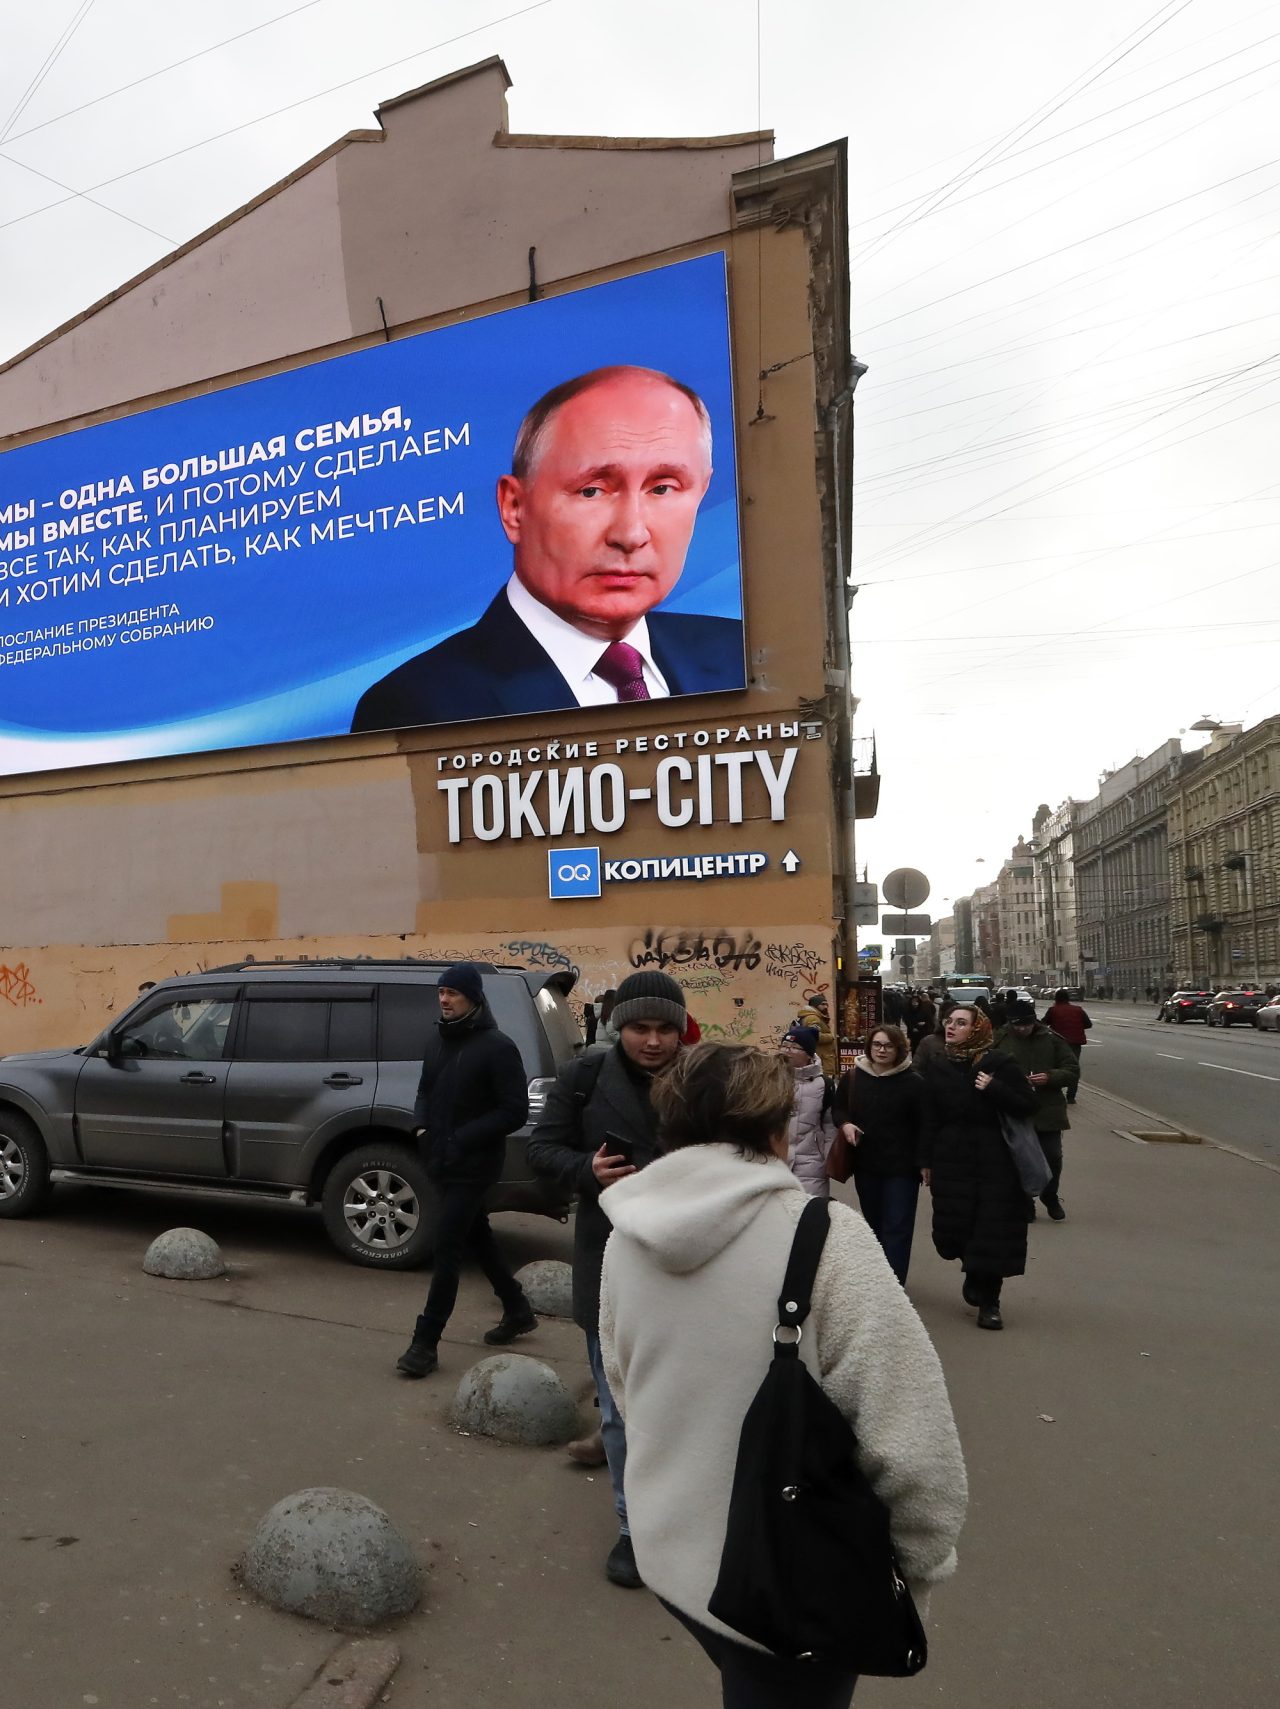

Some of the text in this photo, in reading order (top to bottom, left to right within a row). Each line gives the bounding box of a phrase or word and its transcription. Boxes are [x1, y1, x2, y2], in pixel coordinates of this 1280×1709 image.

[43, 501, 150, 542] ВМЕСТЕ,
[157, 493, 173, 516] И
[184, 462, 305, 509] ПОТОМУ
[315, 423, 469, 480] СДЕЛАЕМ
[60, 475, 135, 510] ОДНА
[143, 436, 285, 490] БОЛЬШАЯ
[295, 406, 411, 451] СЕМЬЯ,
[17, 569, 100, 604] ХОТИМ
[109, 544, 235, 586] СДЕЛАТЬ,
[246, 526, 301, 557] КАК
[311, 492, 463, 544] МЕЧТАЕМ
[44, 542, 94, 569] ТАК,
[103, 528, 151, 557] КАК
[160, 486, 340, 545] ПЛАНИРУЕМ
[79, 604, 179, 633] ПРЕЗИДЕНТА
[121, 616, 213, 643] СОБРАНИЮ
[437, 721, 799, 771] ГОРОДСКИЕ РЕСТОРАНЫ
[604, 853, 766, 881] КОПИЦЕНТР
